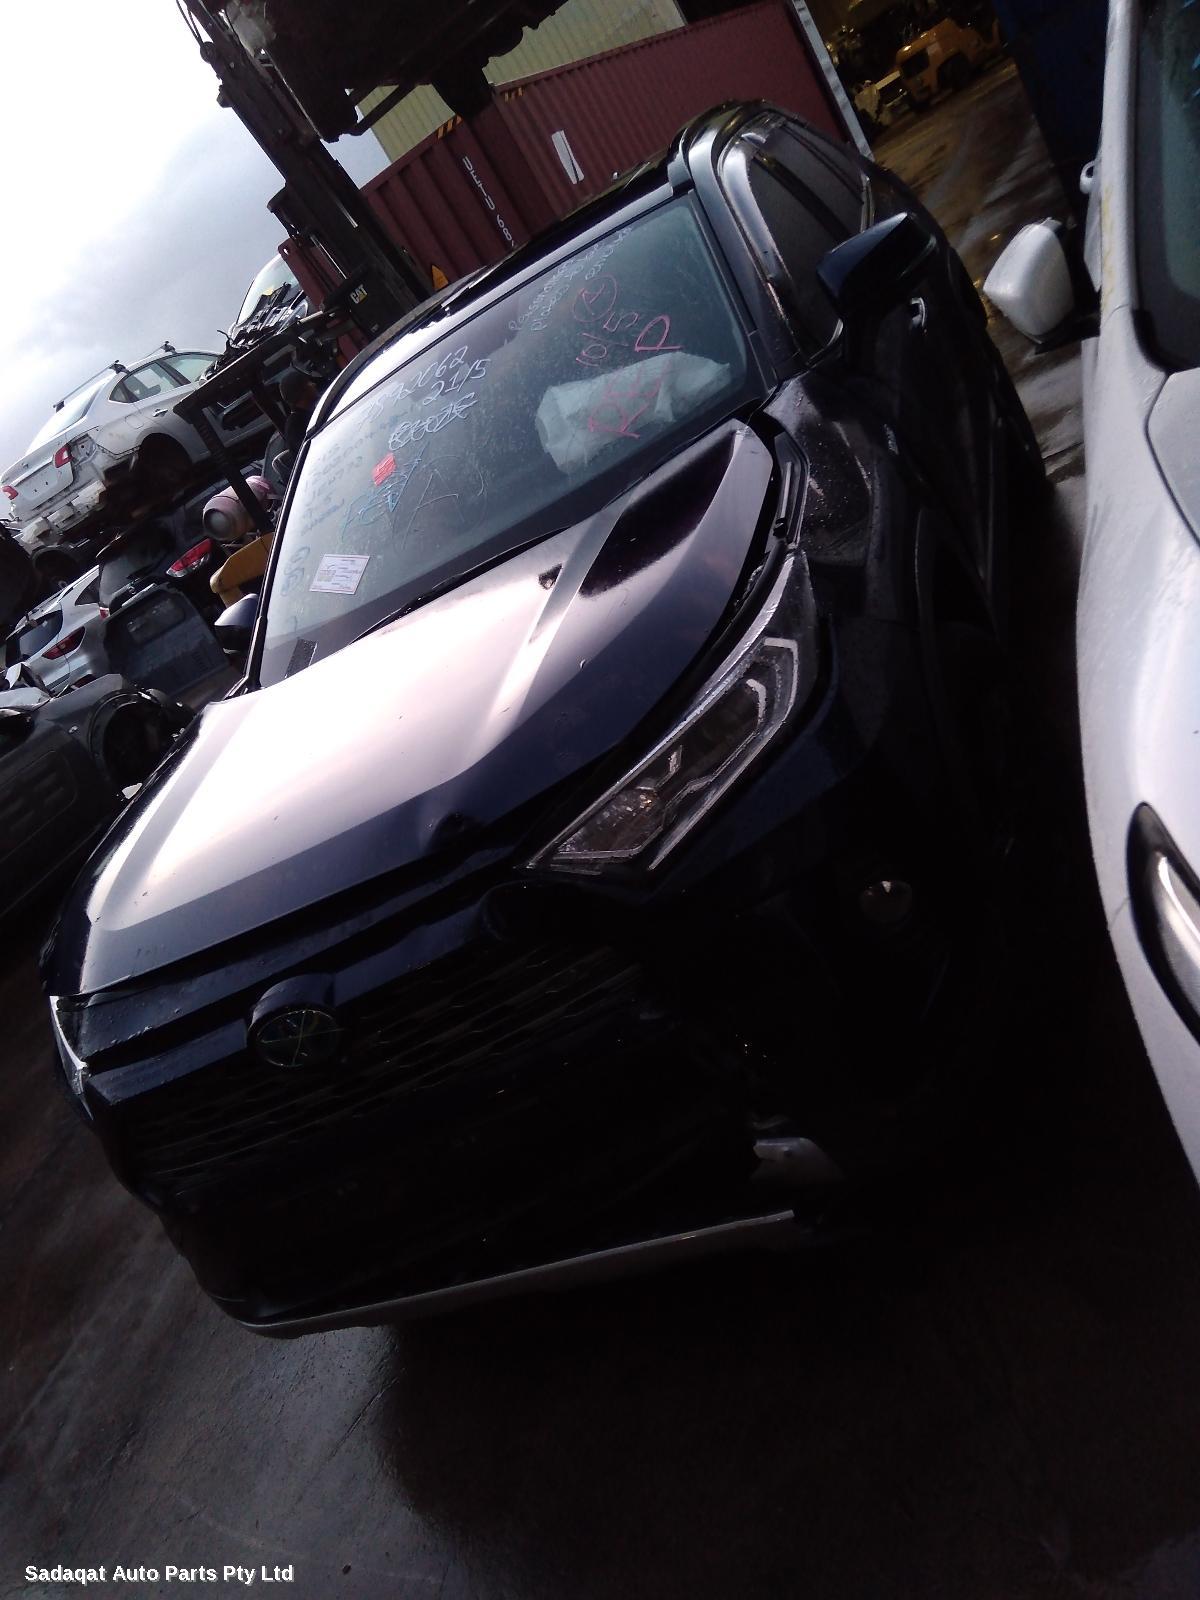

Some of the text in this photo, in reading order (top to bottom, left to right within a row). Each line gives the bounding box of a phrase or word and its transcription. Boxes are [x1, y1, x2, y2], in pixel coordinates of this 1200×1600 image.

[462, 156, 495, 210] UETU
[350, 284, 367, 303] CAT
[423, 359, 491, 406] 21/5
